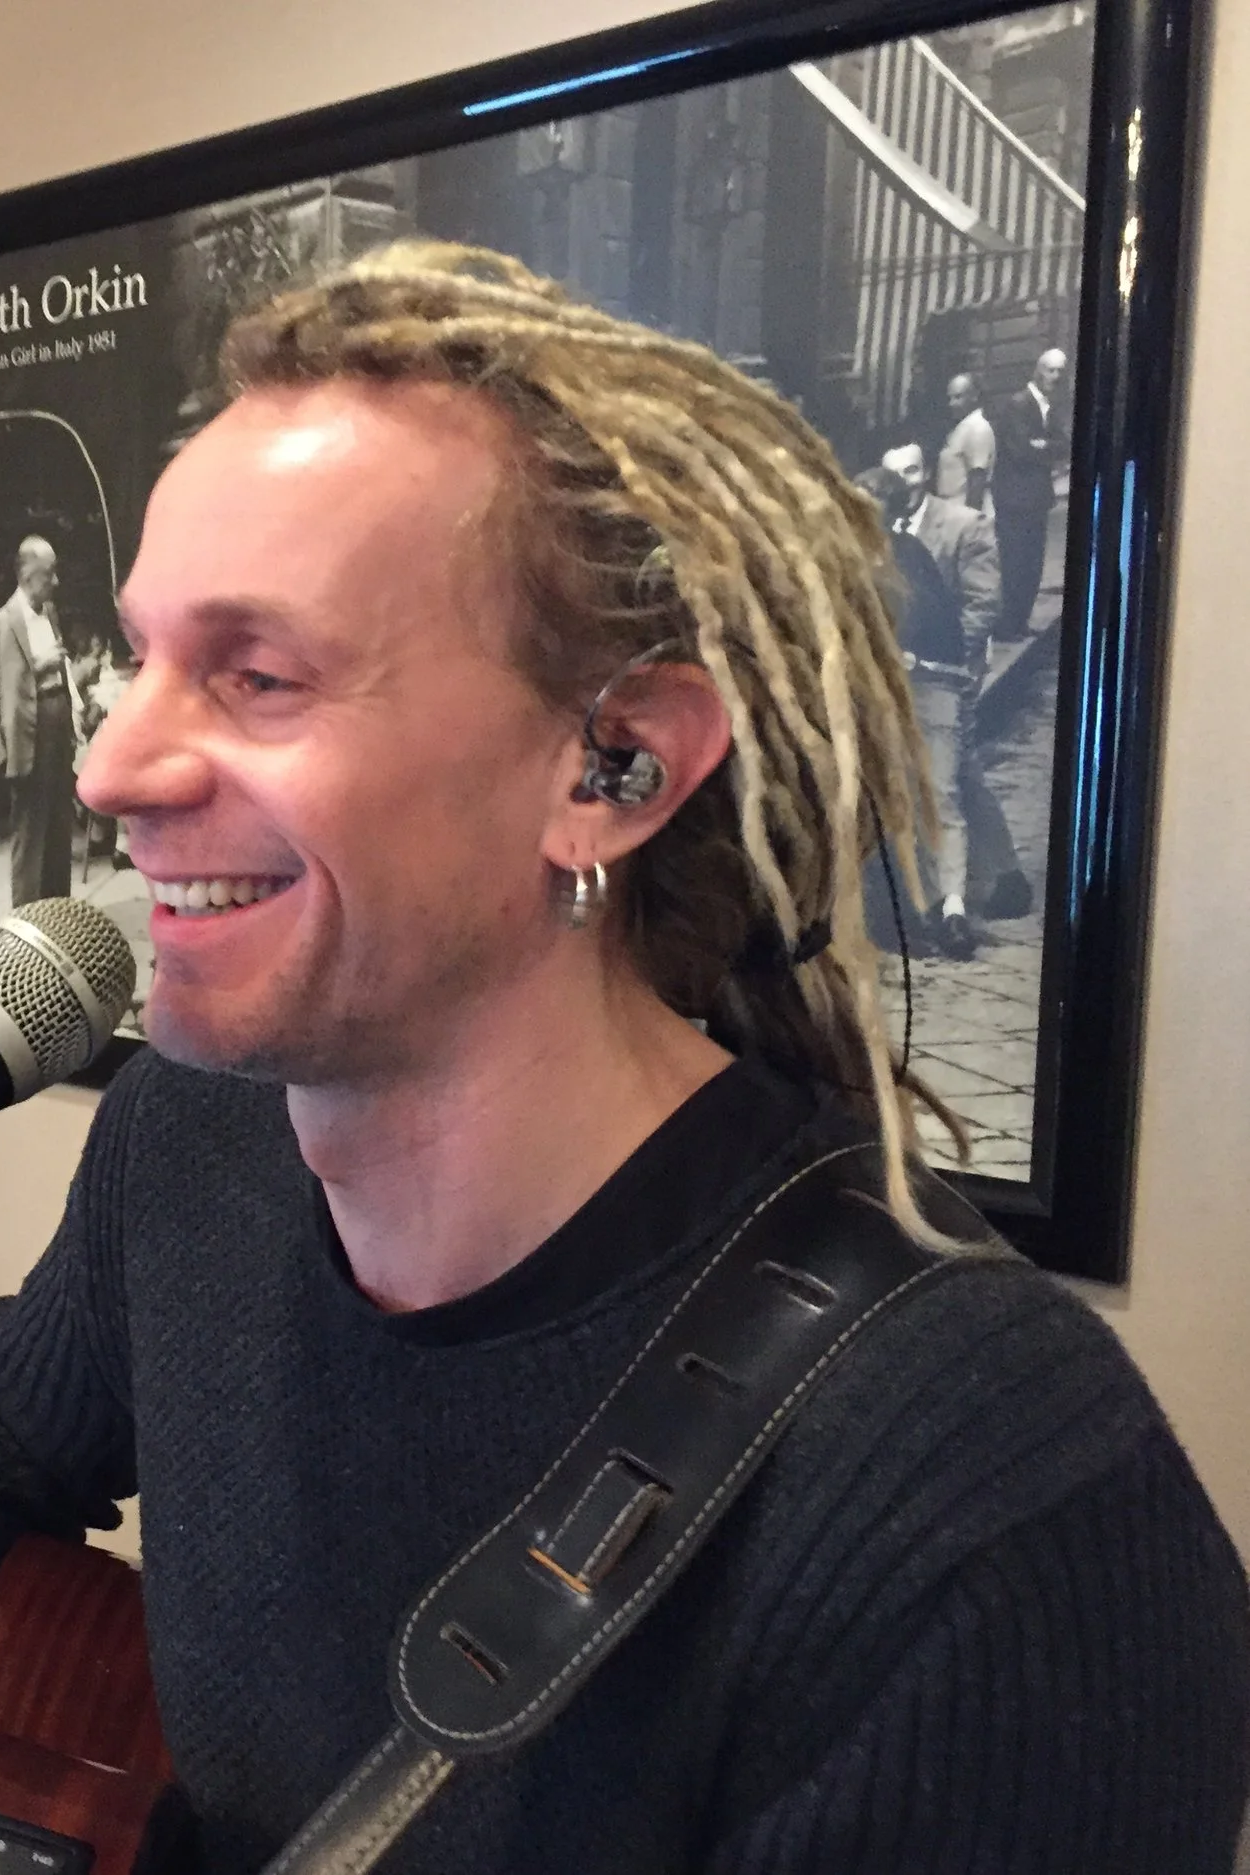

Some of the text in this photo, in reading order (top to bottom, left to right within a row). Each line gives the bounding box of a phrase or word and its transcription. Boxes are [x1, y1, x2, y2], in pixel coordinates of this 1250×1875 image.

[42, 264, 149, 324] Orkin
[11, 343, 36, 367] Girl
[38, 342, 53, 363] in
[55, 336, 85, 362] Italy
